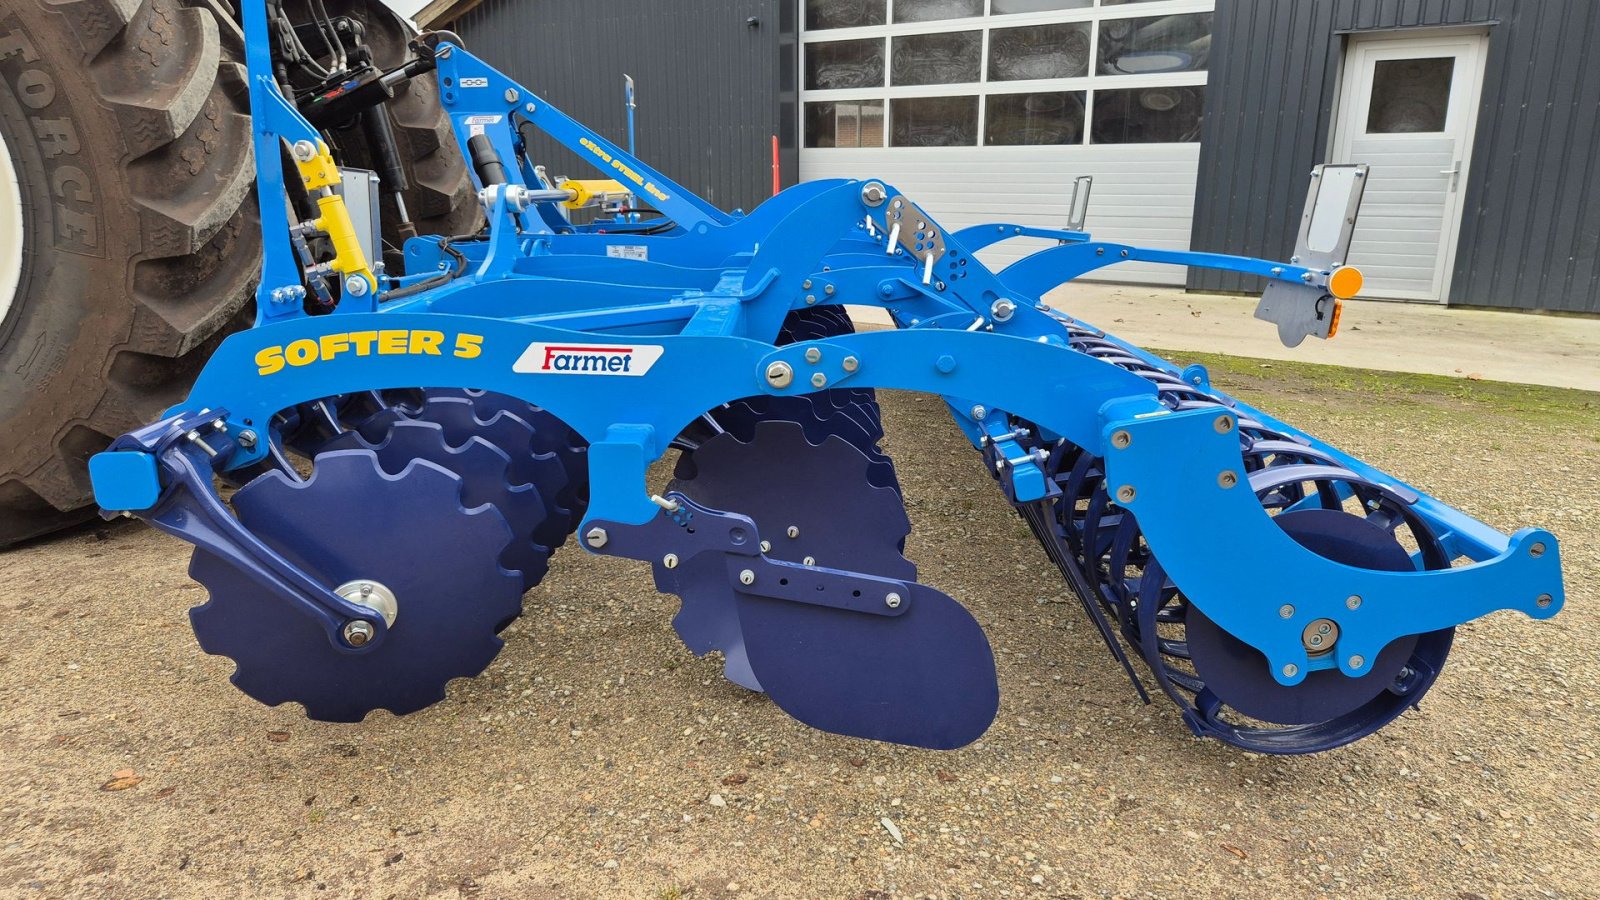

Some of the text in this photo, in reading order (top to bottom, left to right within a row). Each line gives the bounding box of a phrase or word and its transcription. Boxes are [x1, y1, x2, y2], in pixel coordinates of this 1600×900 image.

[0, 29, 98, 249] FORCE
[255, 330, 484, 376] SOFTER 5
[542, 346, 633, 372] Farmet
